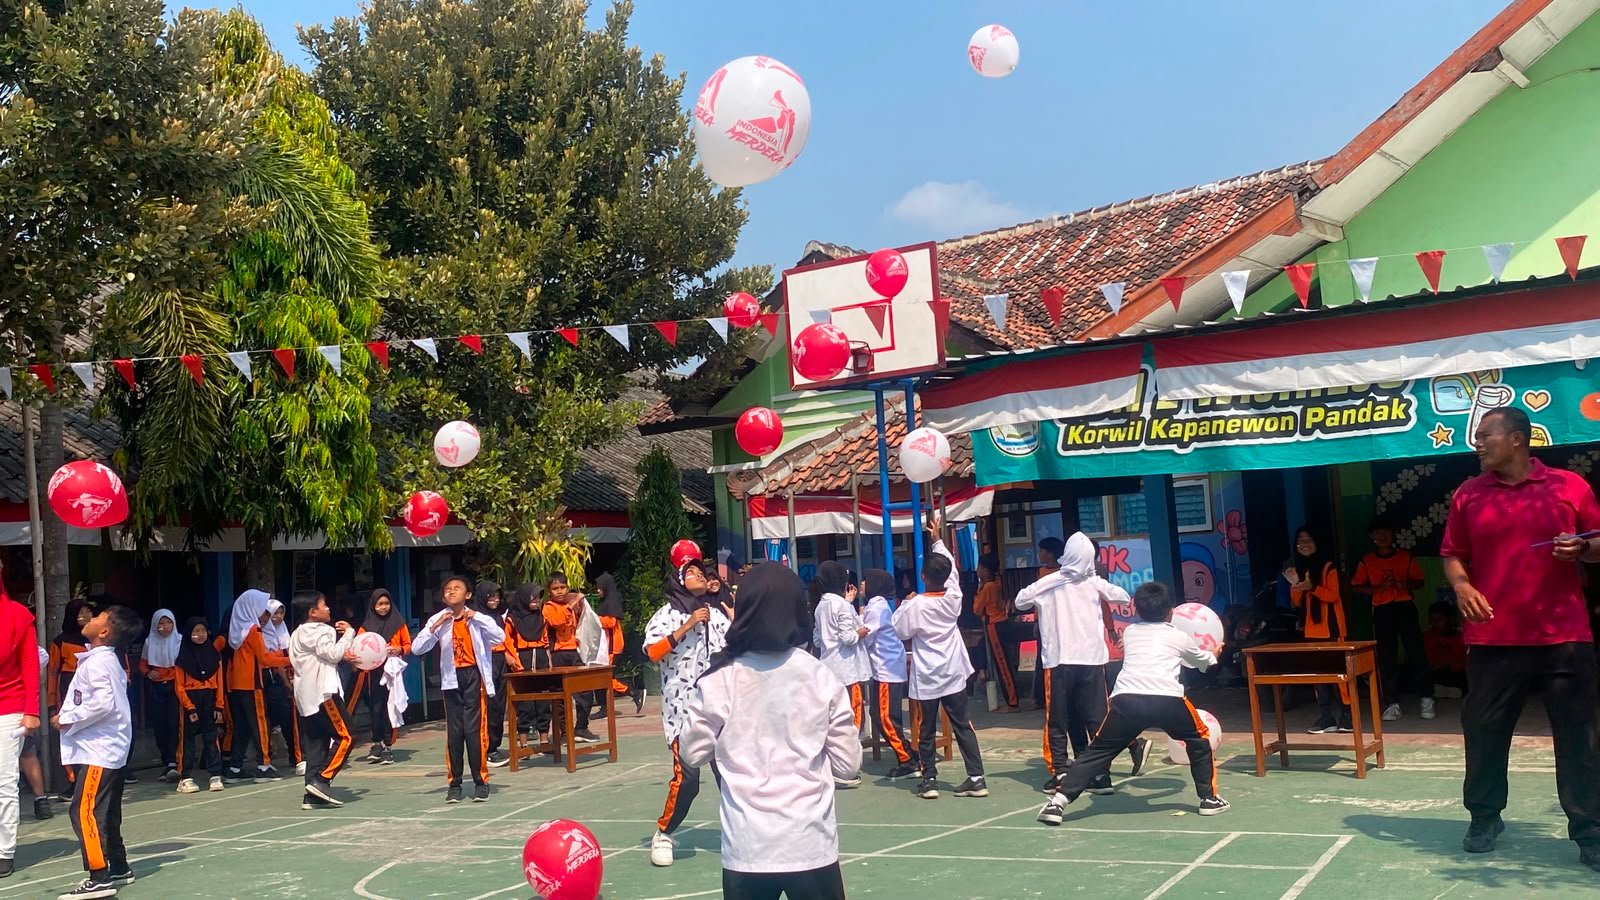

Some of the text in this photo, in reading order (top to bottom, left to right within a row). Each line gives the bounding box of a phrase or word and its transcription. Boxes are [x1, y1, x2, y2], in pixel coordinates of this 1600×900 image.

[724, 126, 785, 164] MERDEKA
[736, 119, 778, 147] INDONESIA
[1067, 397, 1407, 445] Korwil Kapanewon Pandak
